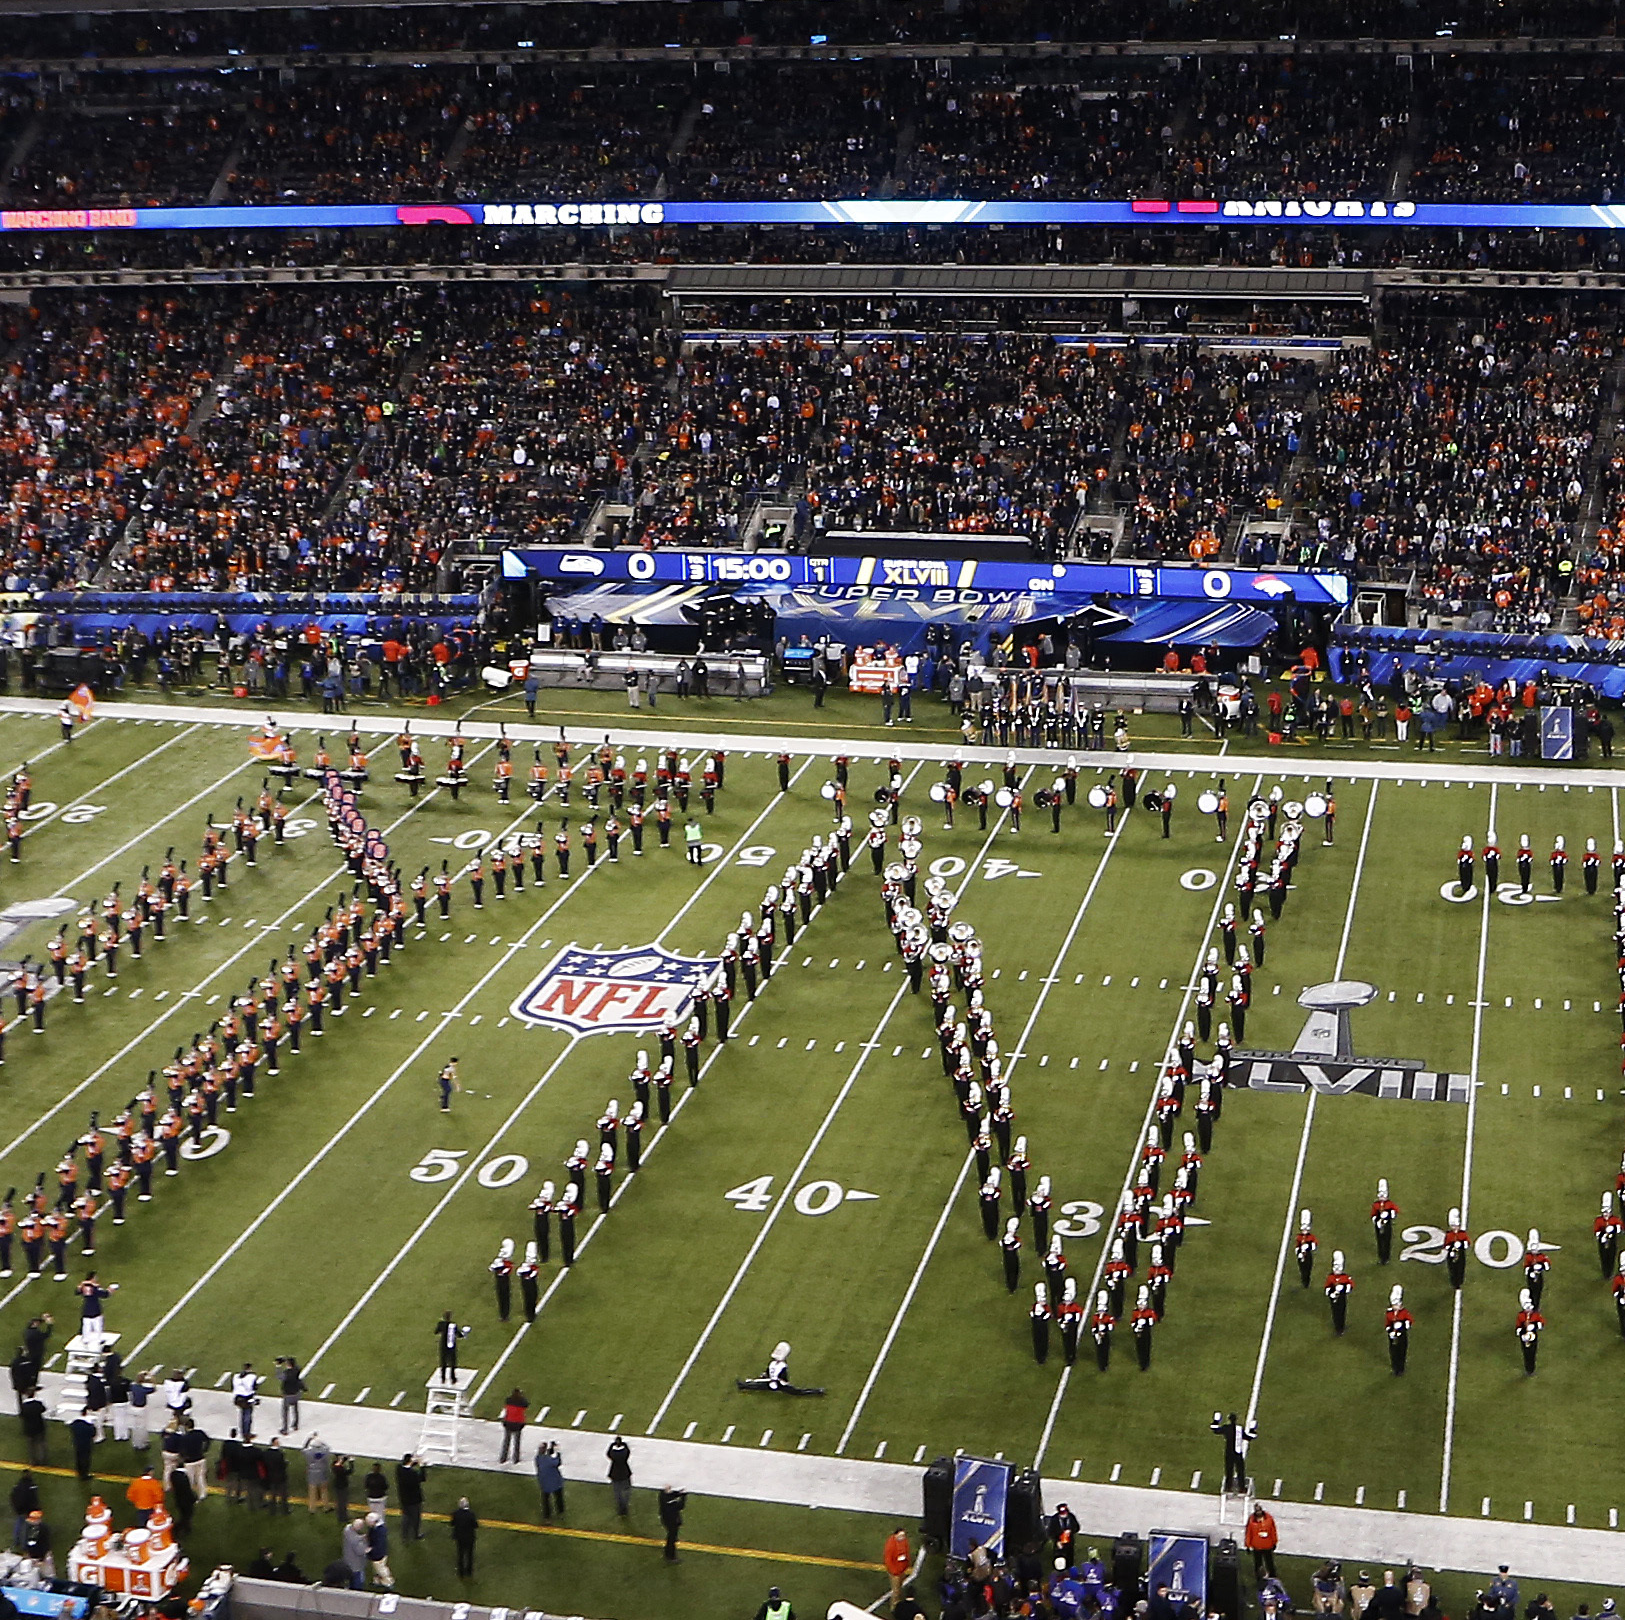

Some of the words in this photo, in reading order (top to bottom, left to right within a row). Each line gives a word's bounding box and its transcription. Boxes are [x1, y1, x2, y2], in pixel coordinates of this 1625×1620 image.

[484, 204, 664, 226] MARCHING
[627, 552, 656, 580] 0
[690, 564, 704, 580] 3
[713, 558, 791, 581] 15:00
[813, 567, 824, 581] 1
[883, 559, 918, 569] SUPER
[919, 560, 949, 570] BOWL
[884, 567, 949, 586] XLVIII
[1028, 578, 1055, 591] ON
[1138, 578, 1154, 594] 3
[1202, 570, 1232, 598] 0
[928, 855, 1021, 880] 40
[535, 978, 668, 1023] NFL
[410, 1147, 530, 1190] 50
[724, 1175, 844, 1216] 40
[1400, 1224, 1525, 1269] 20
[79, 1564, 98, 1584] G
